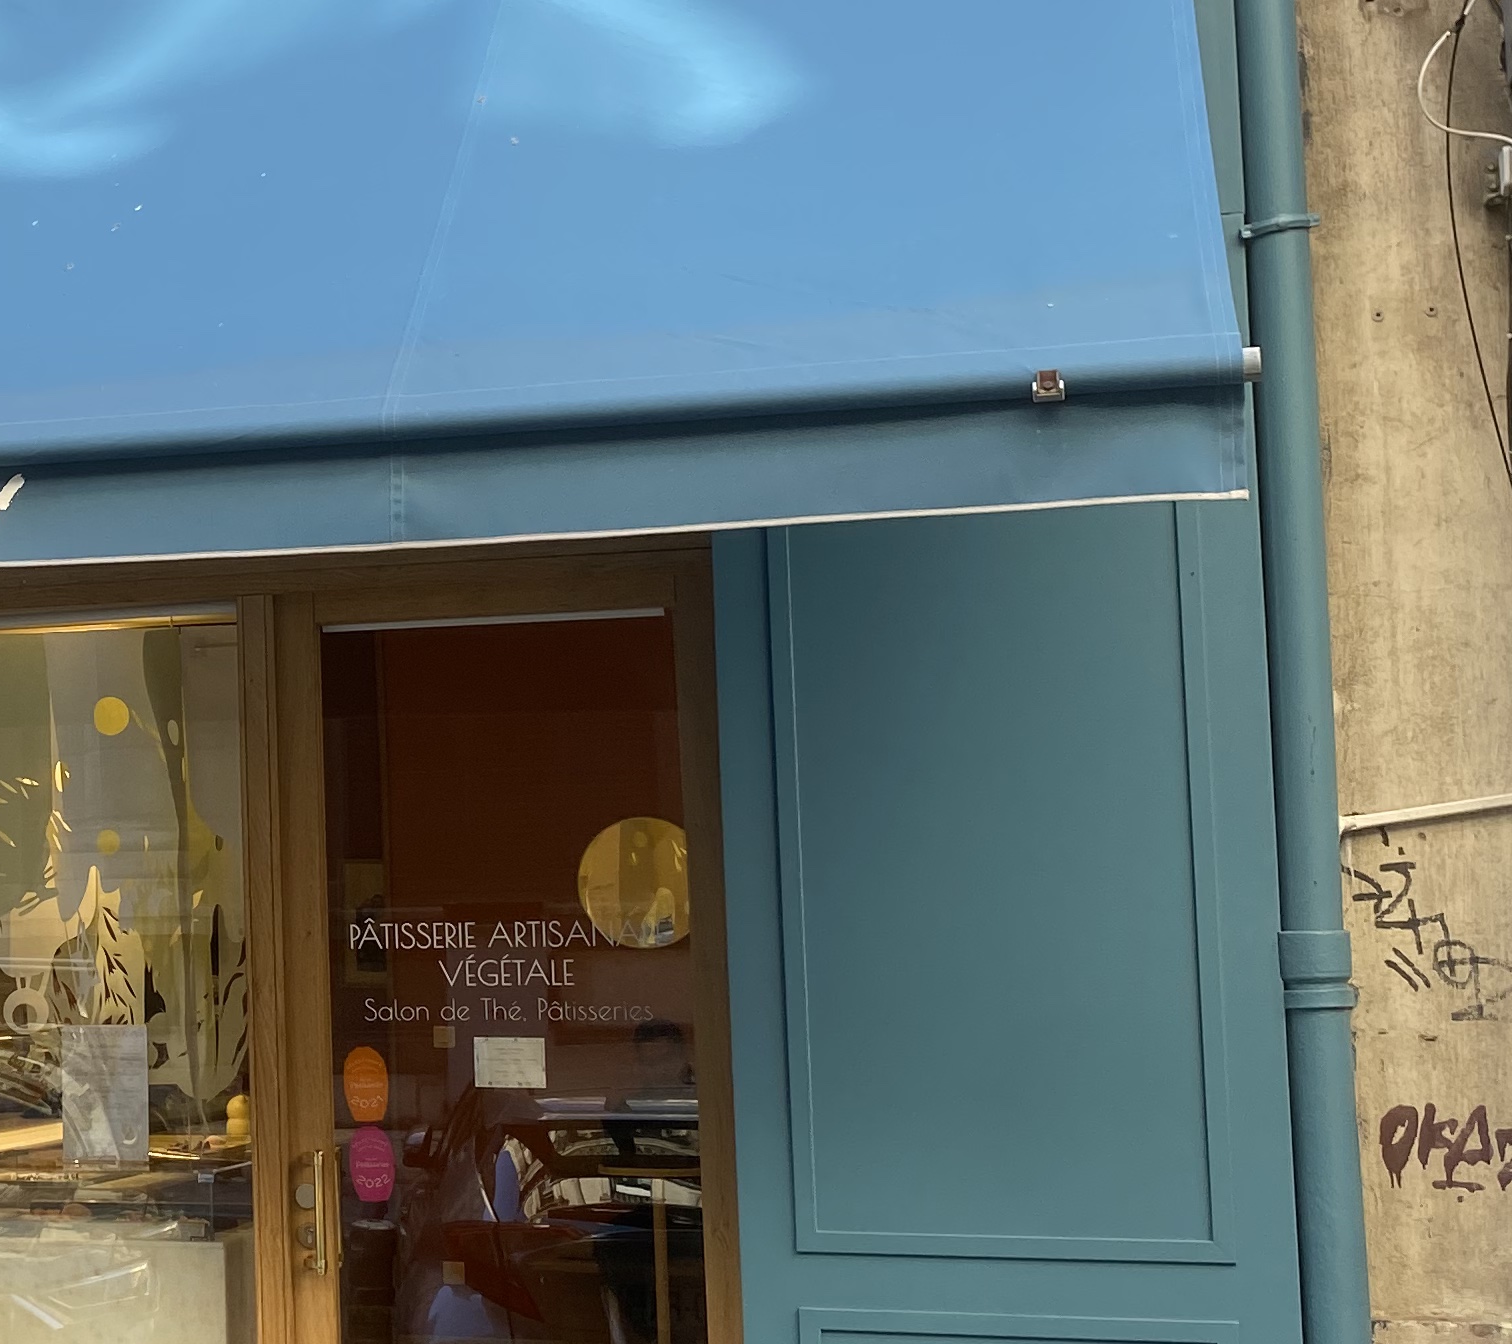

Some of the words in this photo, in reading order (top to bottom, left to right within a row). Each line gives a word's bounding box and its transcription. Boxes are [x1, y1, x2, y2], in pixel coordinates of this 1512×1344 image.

[348, 918, 477, 950] PÂTISSERIE
[488, 919, 675, 949] ARTISANA
[438, 953, 576, 987] VÉGÉTALE
[363, 997, 430, 1022] Salon
[440, 997, 470, 1022] de
[536, 997, 655, 1022] Pâtisseries
[355, 1173, 392, 1189] 2022
